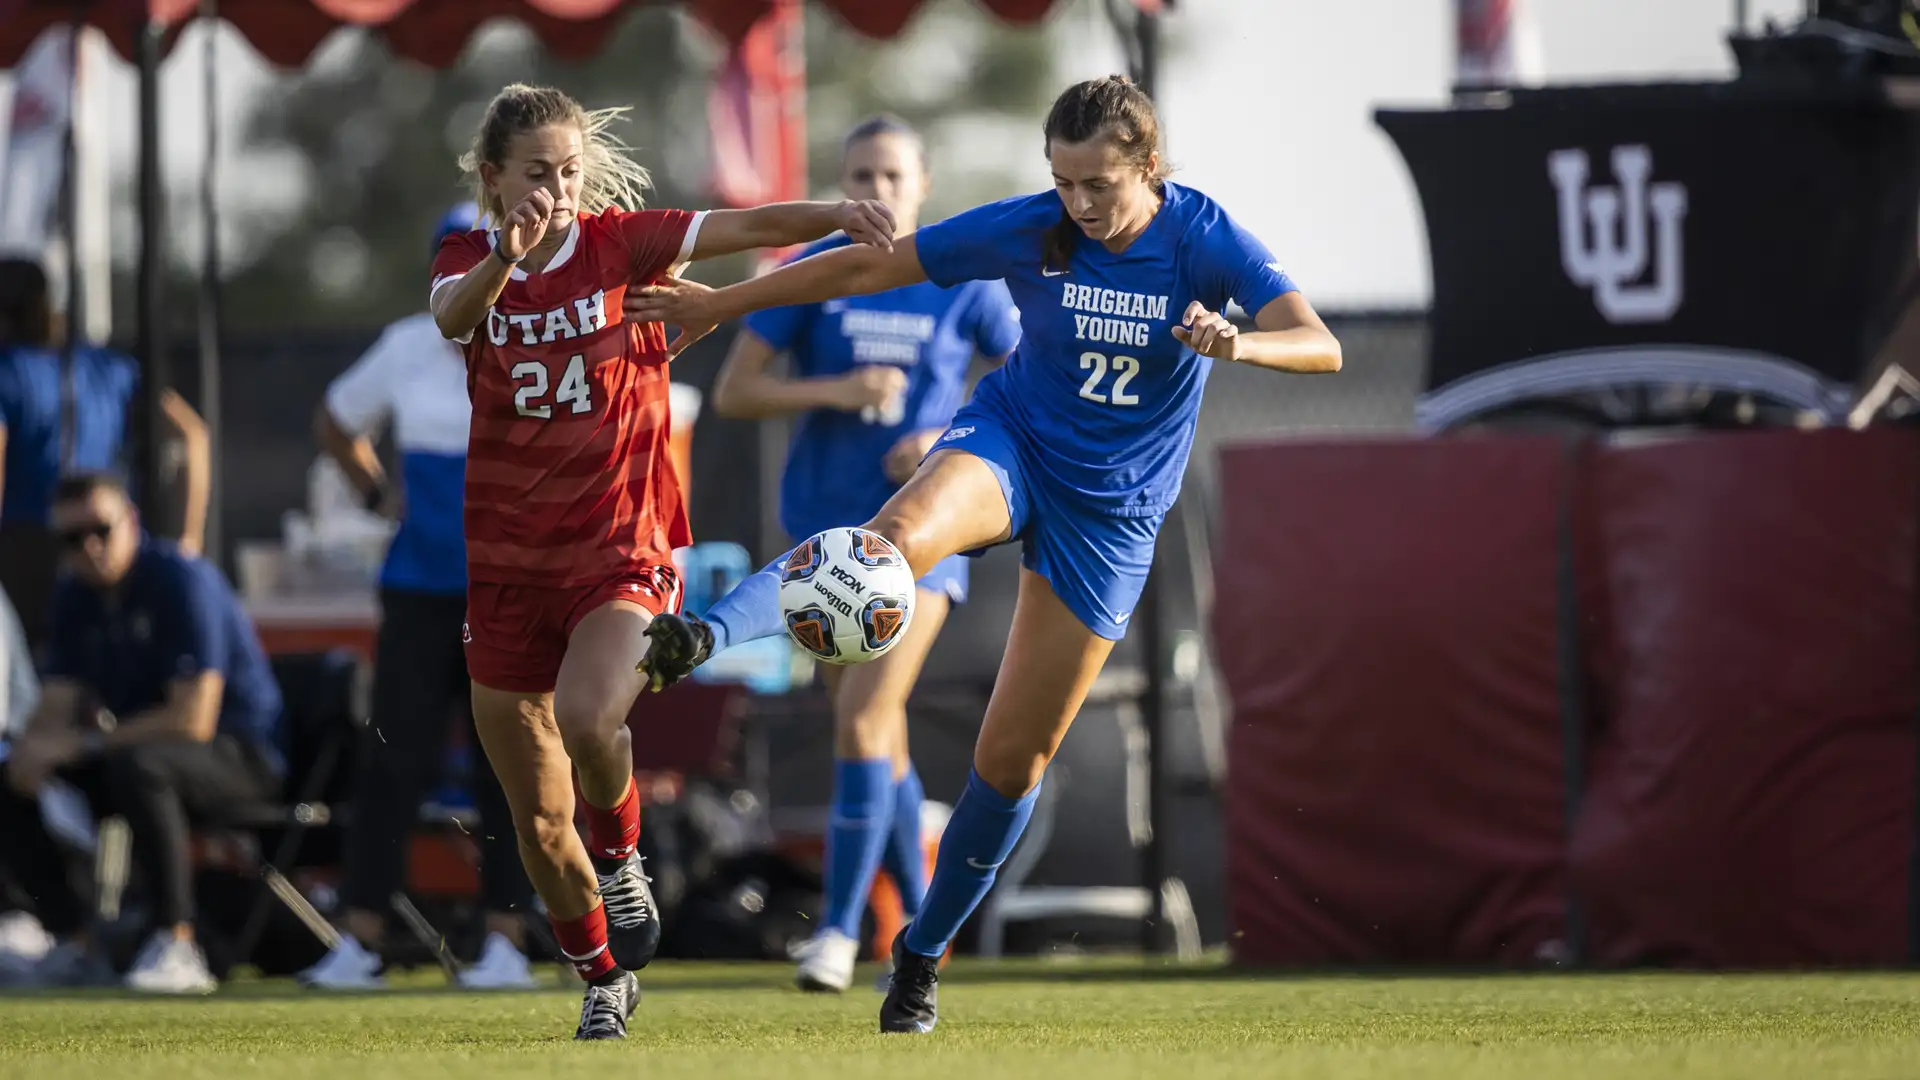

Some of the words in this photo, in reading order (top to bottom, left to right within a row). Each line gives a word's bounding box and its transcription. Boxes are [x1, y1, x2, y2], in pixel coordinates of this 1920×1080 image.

[487, 288, 607, 346] UTAH
[1061, 282, 1168, 320] BRIGHAM
[1074, 313, 1150, 347] YOUNG
[511, 354, 593, 419] 24
[1079, 351, 1140, 405] 22
[829, 565, 866, 594] NCAA
[814, 581, 853, 617] Wilson
